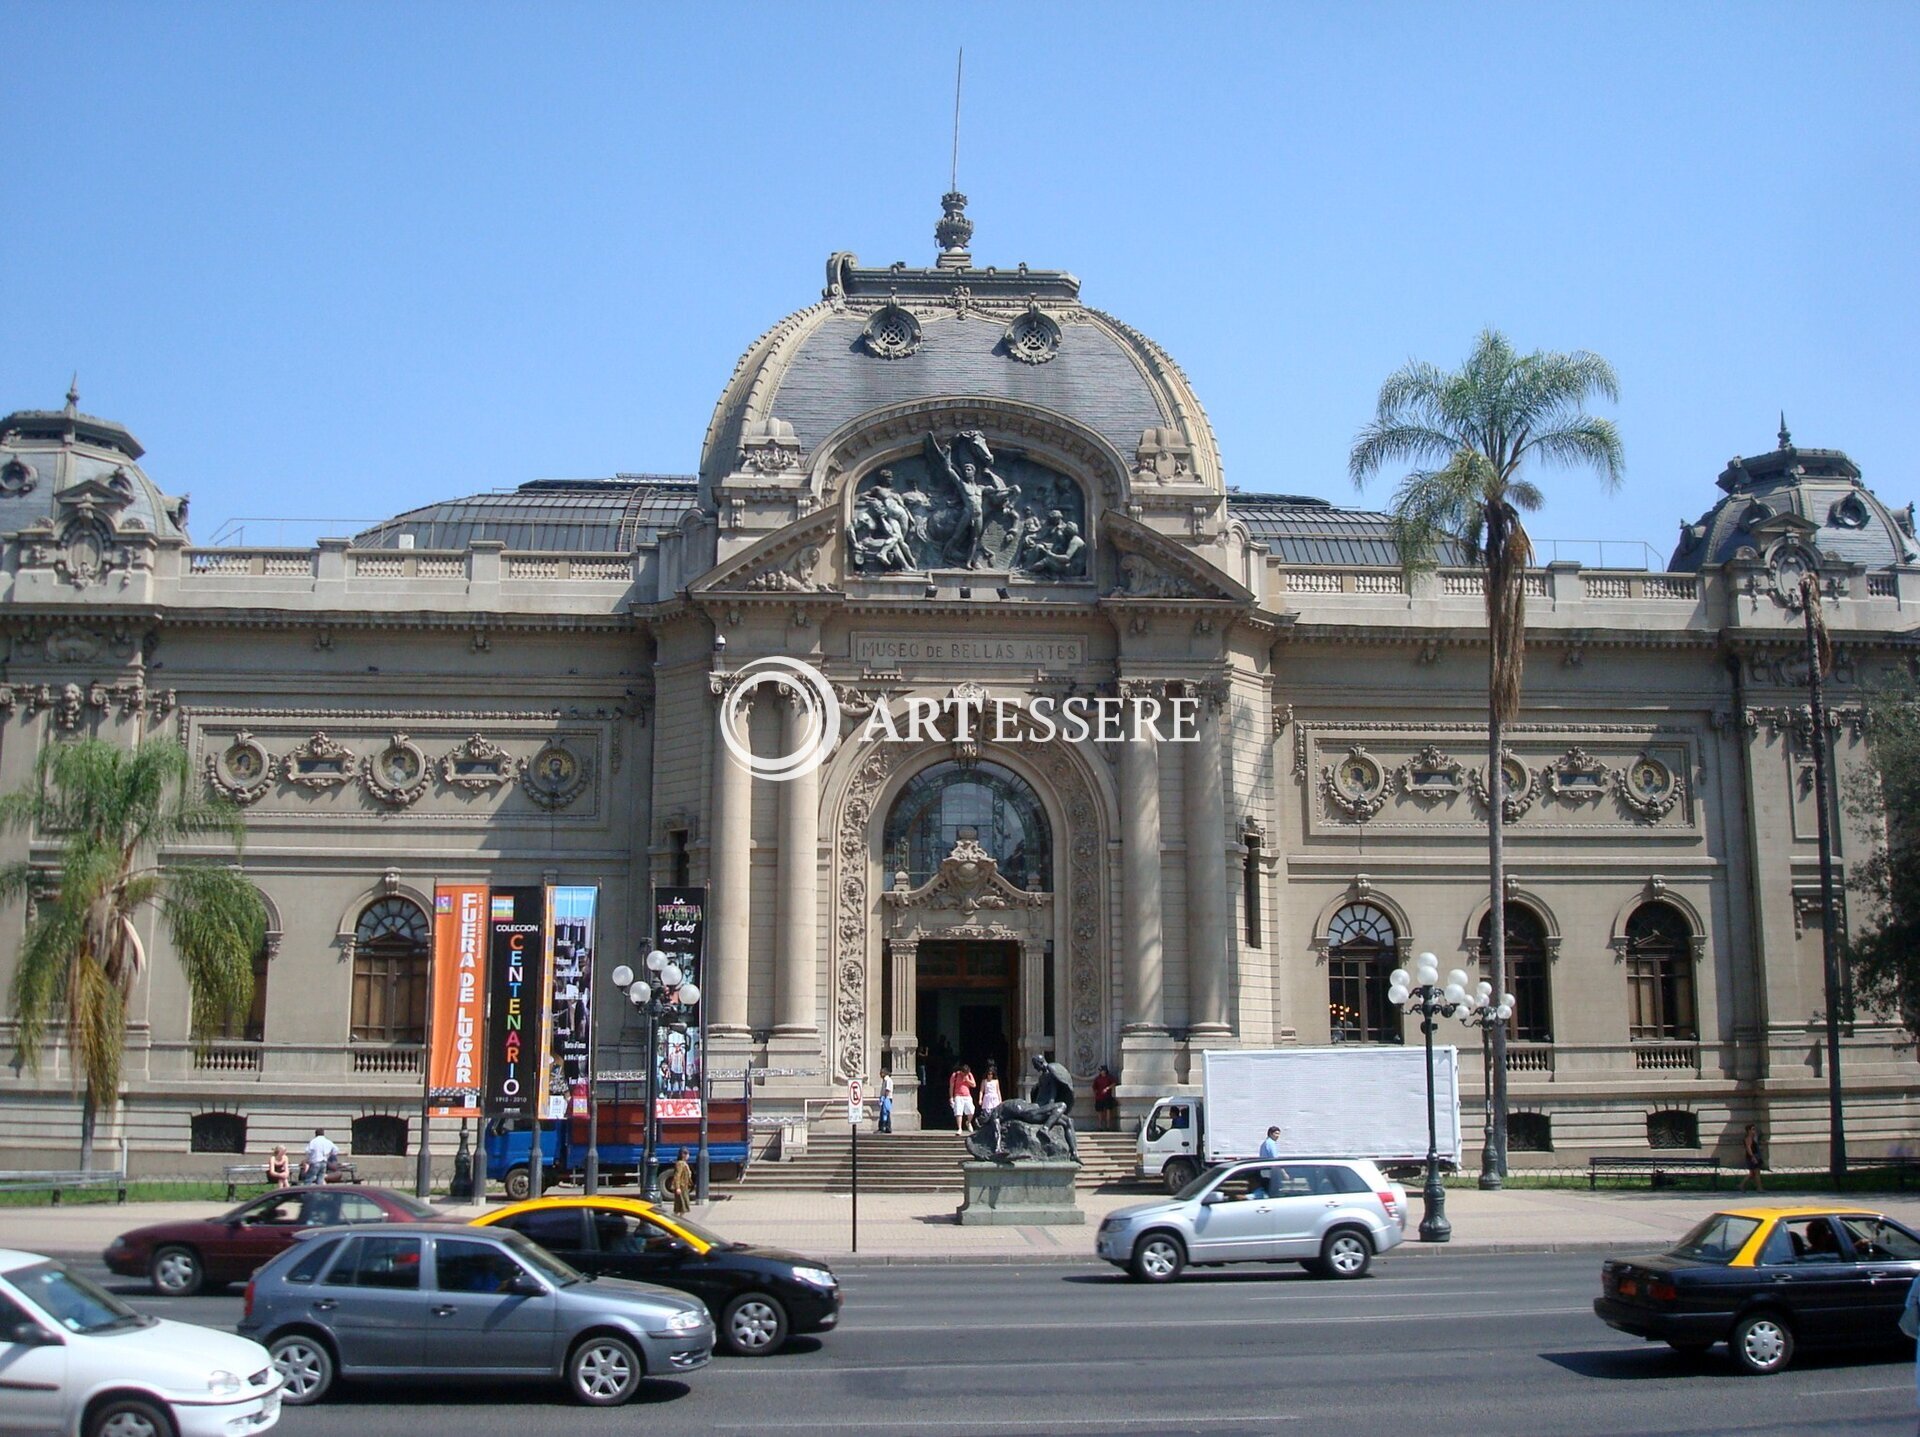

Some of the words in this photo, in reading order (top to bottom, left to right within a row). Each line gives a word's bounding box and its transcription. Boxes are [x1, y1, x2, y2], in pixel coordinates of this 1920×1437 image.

[861, 641, 919, 658] MUSEO
[926, 645, 943, 658] DE
[951, 643, 1014, 659] BELLAS
[1024, 644, 1077, 660] ARTES
[459, 893, 477, 968] FUERA
[661, 920, 673, 932] de
[673, 920, 696, 934] todos
[459, 972, 475, 1003] DE
[503, 934, 524, 1095] CENTENARIO
[456, 1007, 473, 1084] LUGAR
